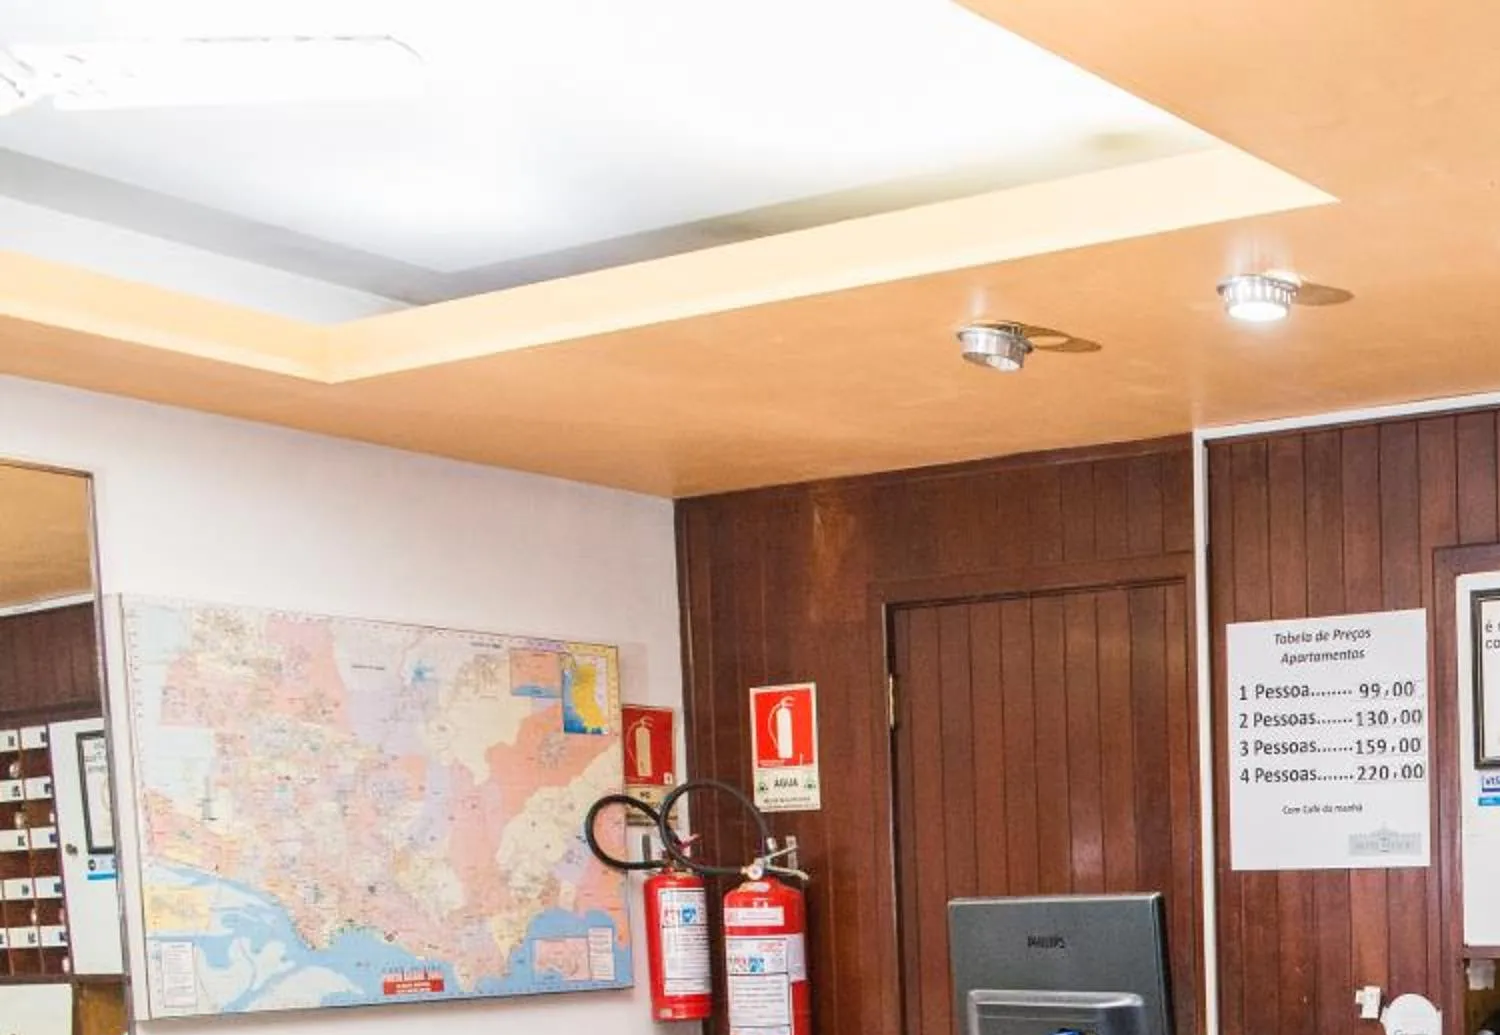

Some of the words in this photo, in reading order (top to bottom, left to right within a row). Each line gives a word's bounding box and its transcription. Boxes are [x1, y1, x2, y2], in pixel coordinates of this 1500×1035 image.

[1274, 630, 1313, 645] Tabela
[1316, 629, 1330, 643] de
[1332, 627, 1372, 644] Preços
[1280, 649, 1366, 666] Apartamentos
[1239, 684, 1248, 701] 1
[1239, 713, 1249, 729] 2
[1239, 740, 1249, 757] 3
[1239, 767, 1250, 784] 4
[1322, 803, 1333, 814] da
